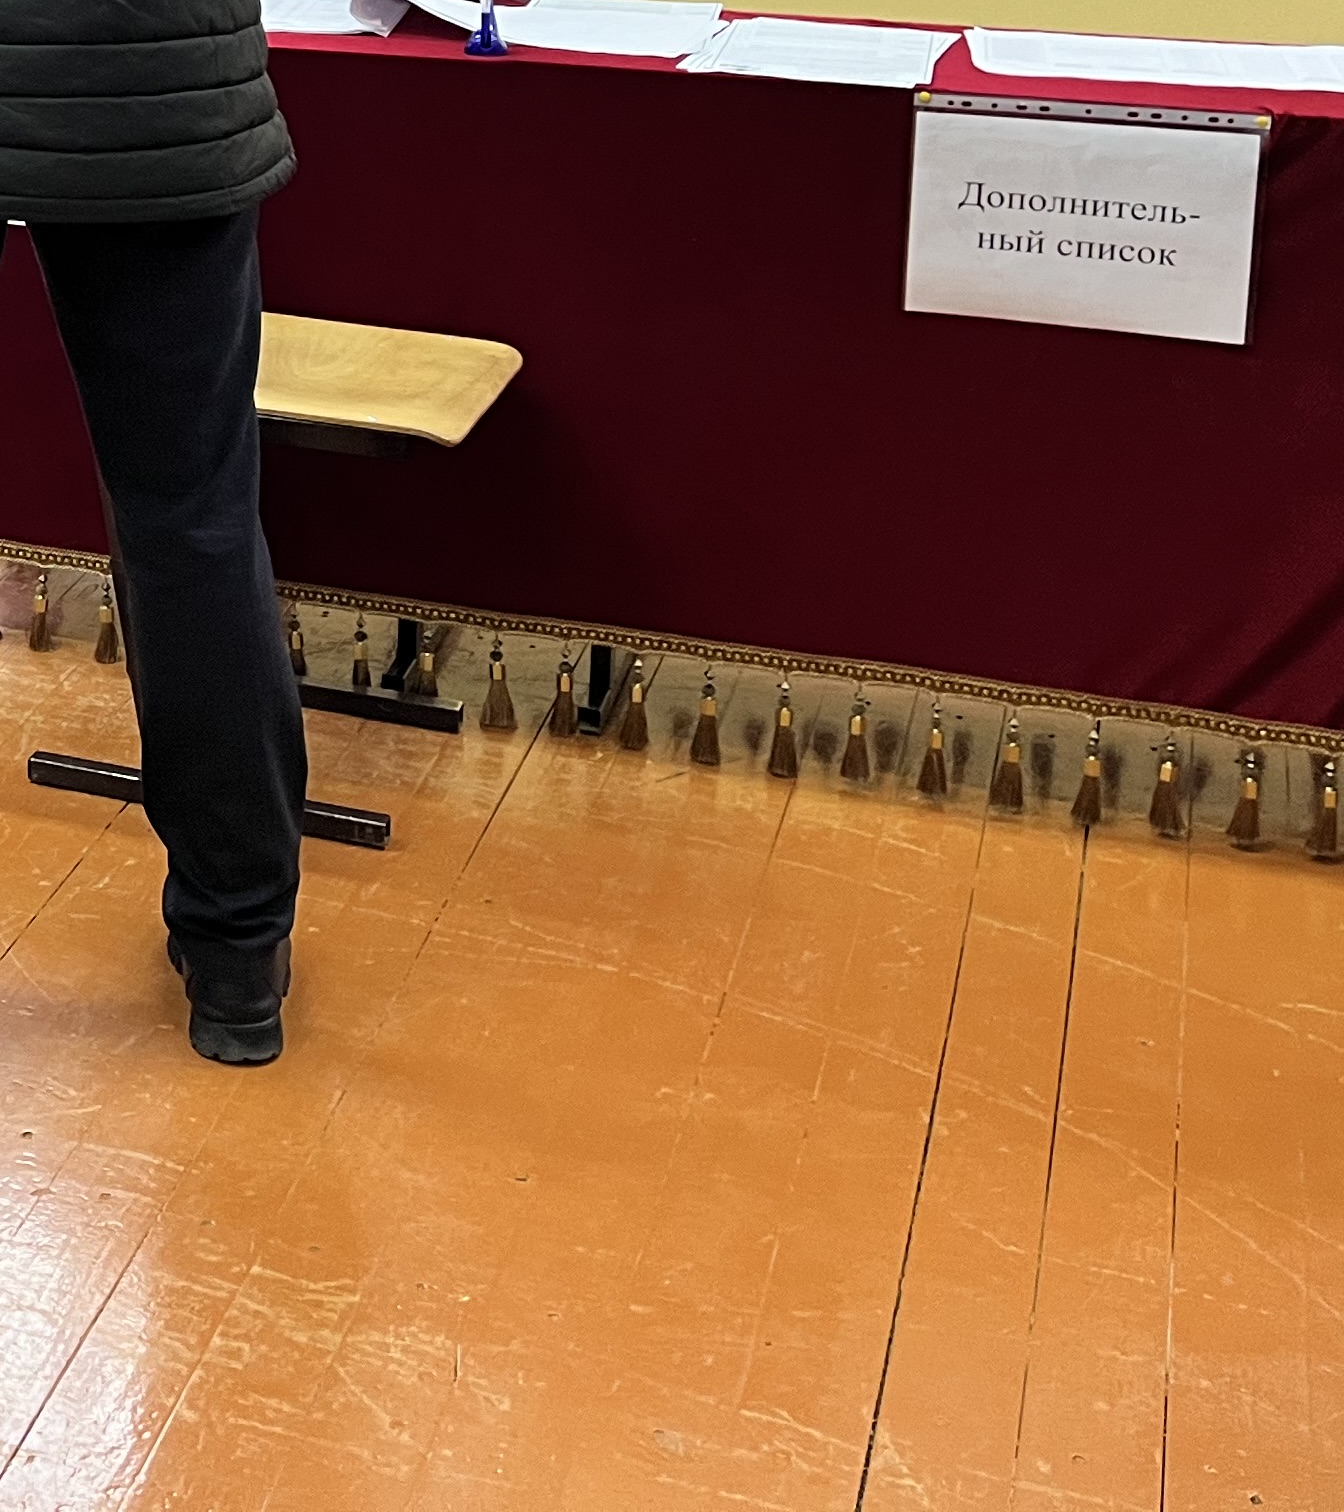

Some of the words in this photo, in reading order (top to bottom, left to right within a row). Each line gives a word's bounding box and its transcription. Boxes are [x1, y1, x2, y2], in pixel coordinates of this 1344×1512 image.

[957, 180, 1201, 226] Дополнитель-
[977, 230, 1045, 255] ный
[1056, 238, 1178, 268] список
